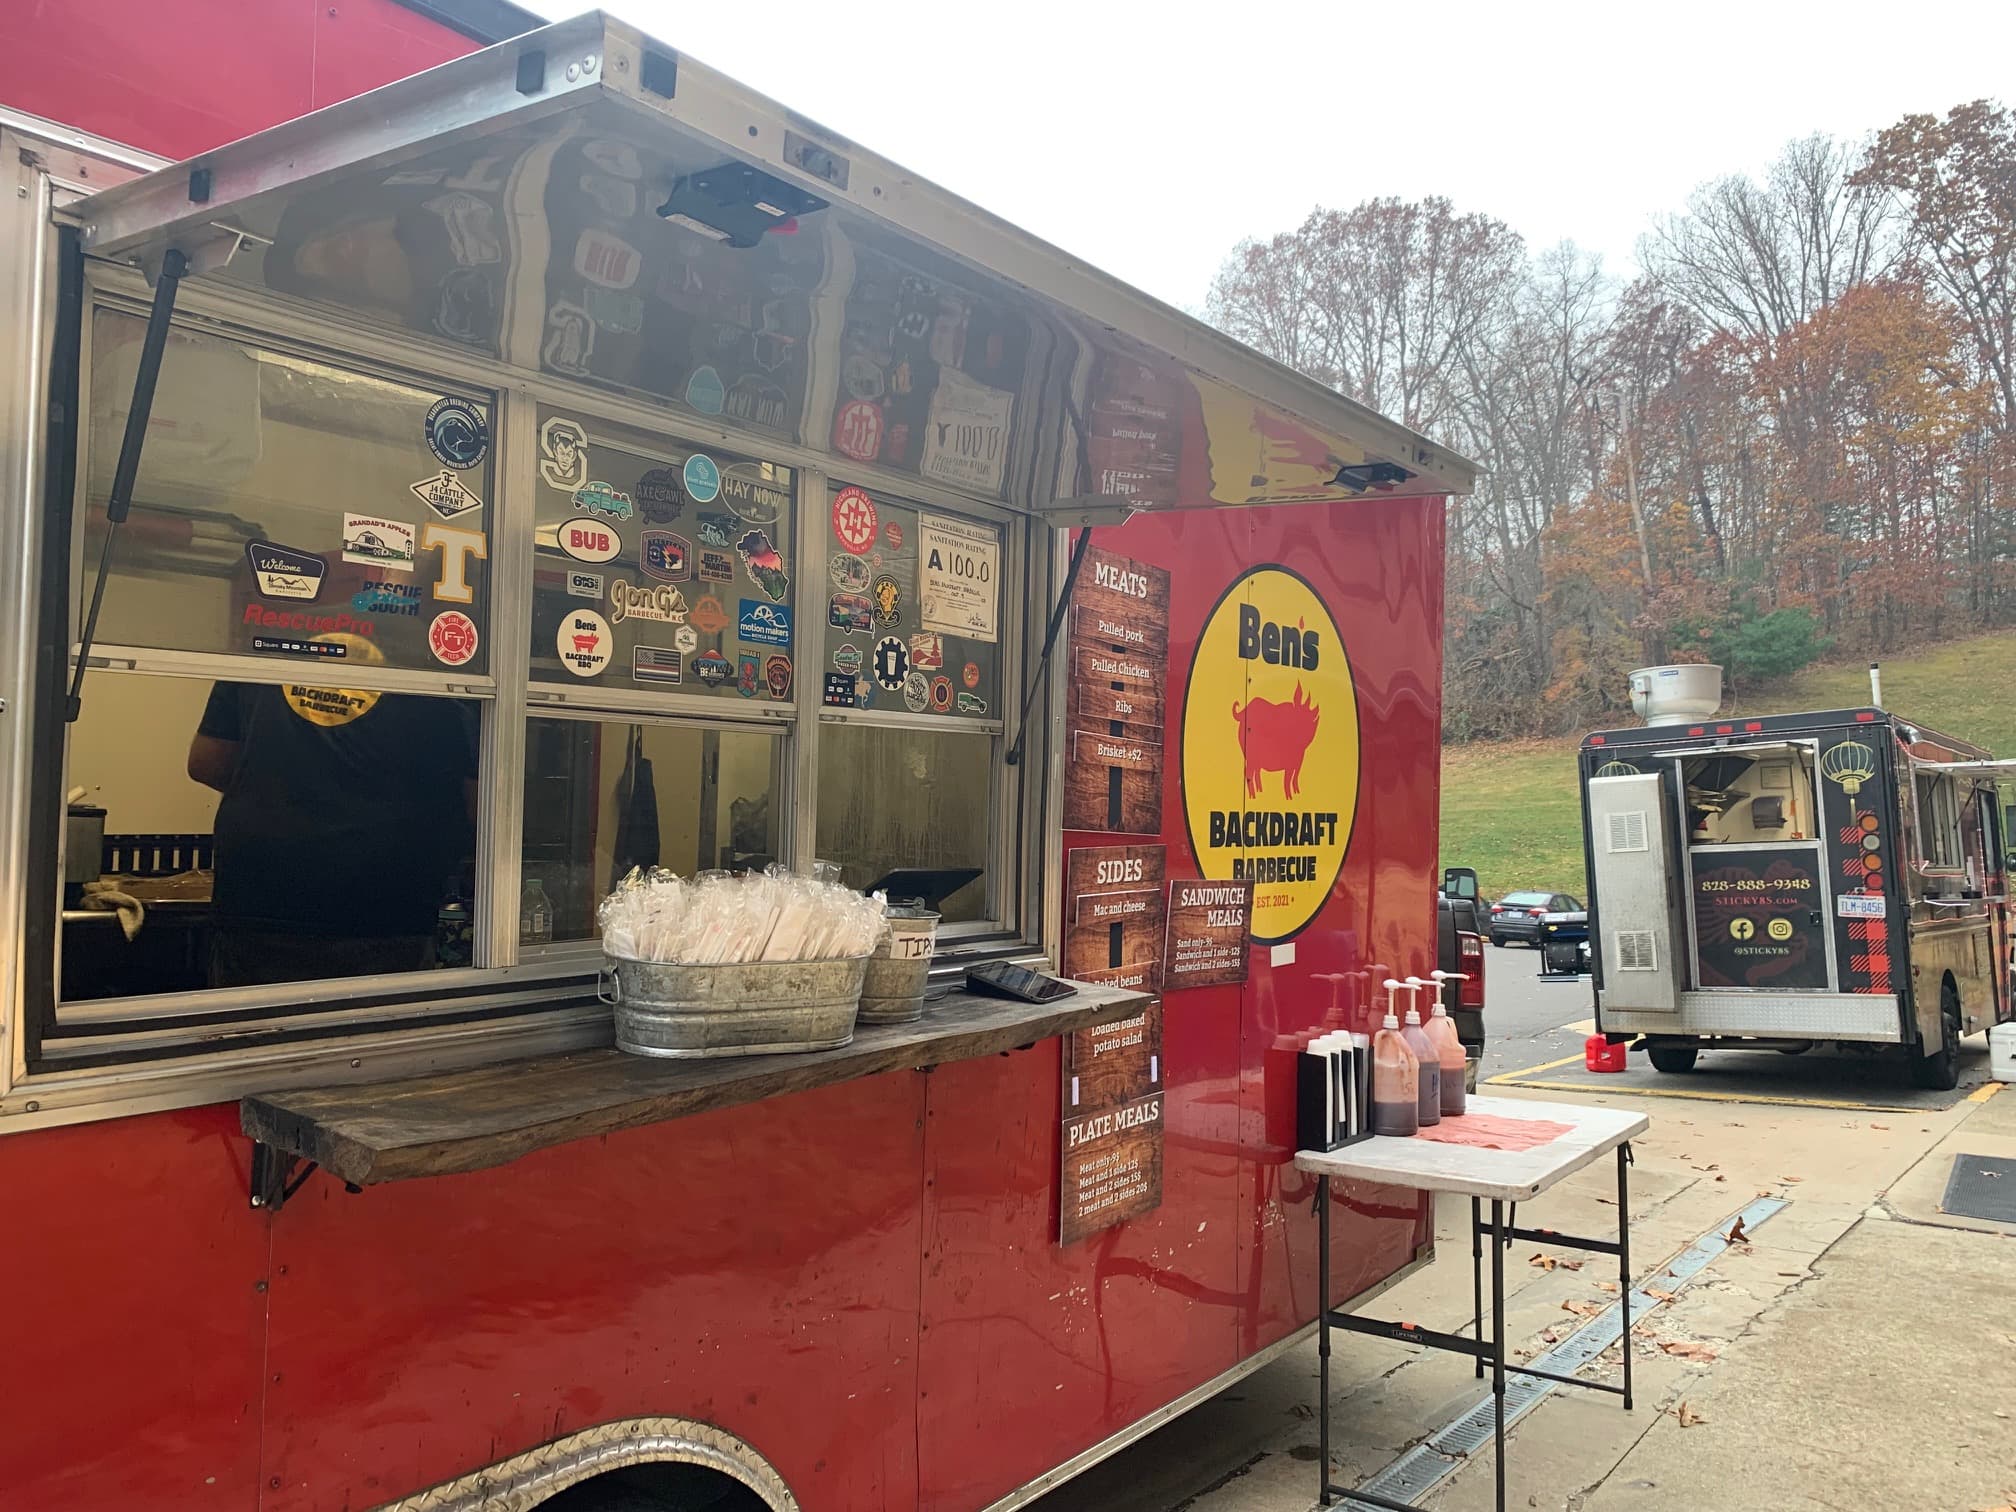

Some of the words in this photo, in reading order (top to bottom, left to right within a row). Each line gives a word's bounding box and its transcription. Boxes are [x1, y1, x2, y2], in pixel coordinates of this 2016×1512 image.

[429, 493, 464, 507] COMPANY
[440, 486, 465, 499] CATTLE
[726, 477, 750, 499] HAY
[753, 486, 781, 507] NOW
[348, 520, 386, 528] GRANDAD'S
[387, 523, 411, 538] APPLES
[570, 529, 610, 551] BUB
[930, 535, 964, 549] SANITATION
[966, 543, 986, 555] RATING
[260, 558, 302, 572] Welcome
[421, 522, 487, 603] T
[928, 548, 943, 572] A
[949, 552, 989, 582] 100.0
[1095, 562, 1147, 598] MEATS
[243, 604, 375, 635] RescuePro
[628, 609, 663, 620] BARBECUE
[575, 619, 597, 631] Ben's
[740, 623, 764, 633] motion
[765, 628, 789, 637] makers
[1098, 620, 1124, 637] Pulled
[1126, 630, 1144, 643] pork
[445, 631, 464, 645] FT
[1239, 603, 1319, 671] Ben's
[565, 652, 604, 663] BACKDRAFT
[578, 661, 592, 669] BBQ
[1092, 658, 1116, 673] Pulled
[1118, 660, 1149, 678] Chicken
[291, 685, 365, 709] BACKDRAFT
[300, 700, 348, 716] BARBECUE
[1115, 700, 1132, 713] Ribs
[1098, 744, 1126, 758] Brisket
[1128, 748, 1142, 761] +$2
[1209, 810, 1337, 848] BACKDRAFT
[1097, 859, 1142, 884] SIDES
[1233, 856, 1316, 884] BARBECUE
[1702, 878, 1811, 891] 828-888-9348
[1181, 888, 1245, 906] SANDWICH
[1256, 896, 1271, 908] EST.
[1273, 894, 1289, 906] 2021
[1094, 904, 1108, 916] Mac
[1109, 901, 1122, 914] and
[1123, 900, 1146, 913] cheese
[1207, 909, 1243, 928] MEALS
[1177, 938, 1191, 948] Sand
[1176, 950, 1202, 960] Sandwich
[1203, 948, 1213, 958] and
[1217, 947, 1228, 956] side
[1174, 962, 1200, 973] Sandwich
[1201, 960, 1212, 970] and
[1212, 960, 1216, 968] 2
[1120, 974, 1143, 988] beans
[1094, 1038, 1120, 1058] potato
[1121, 1031, 1142, 1047] salad
[1070, 1114, 1112, 1147] PLATE
[1114, 1100, 1159, 1132] MEALS
[1080, 1161, 1095, 1174] Meat
[1080, 1175, 1095, 1188] Meat
[1096, 1169, 1108, 1182] and
[1113, 1163, 1127, 1176] side
[1128, 1158, 1138, 1171] 12$
[1079, 1188, 1094, 1203] Meat
[1096, 1182, 1108, 1196] and
[1108, 1181, 1113, 1191] 2
[1114, 1176, 1130, 1189] sides
[1131, 1171, 1141, 1183] 15$
[1079, 1207, 1083, 1217] 2
[1083, 1200, 1100, 1215] meat
[1101, 1194, 1114, 1208] and
[1114, 1192, 1119, 1202] 2
[1119, 1187, 1135, 1200] sides
